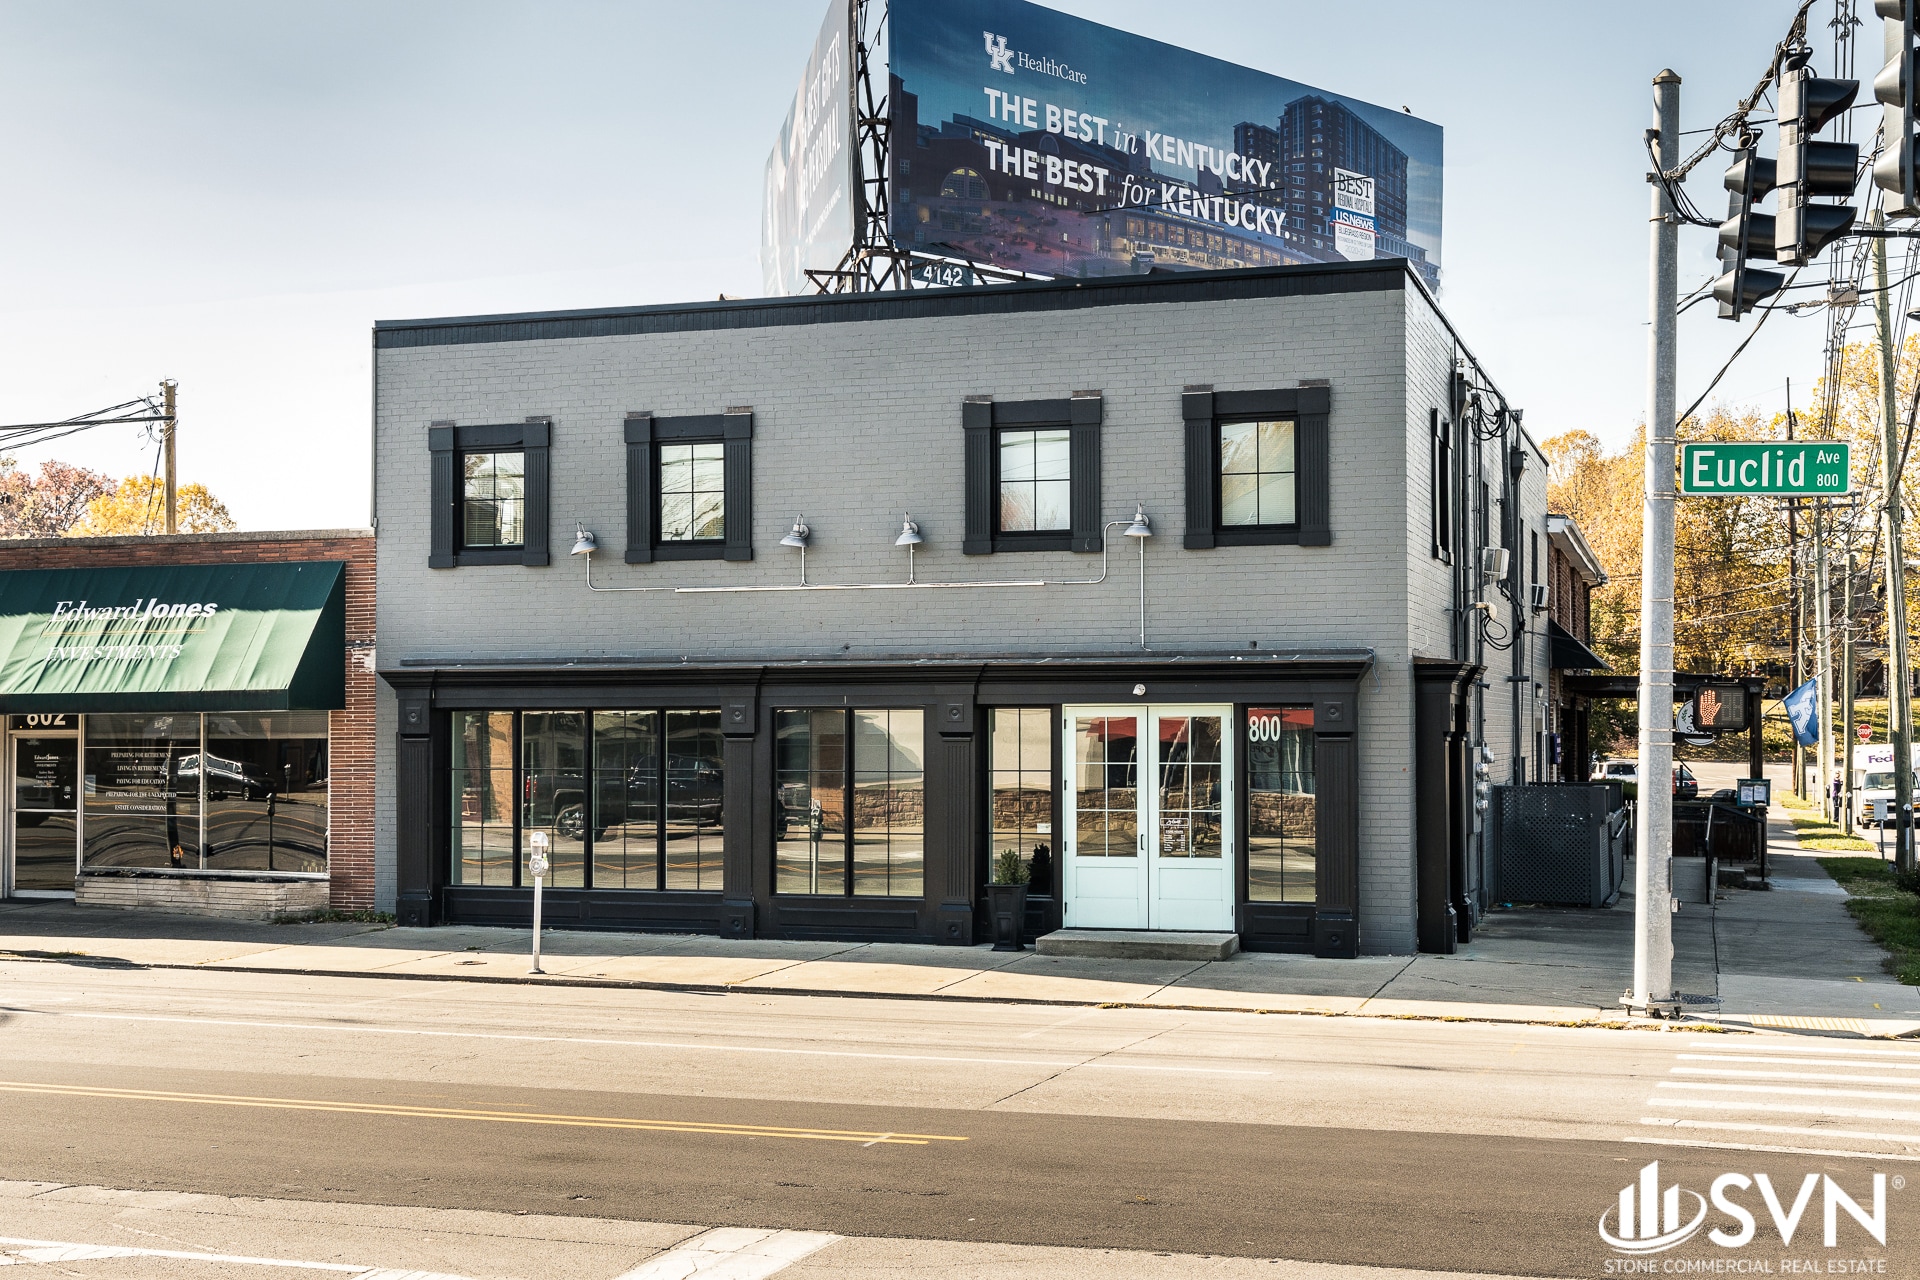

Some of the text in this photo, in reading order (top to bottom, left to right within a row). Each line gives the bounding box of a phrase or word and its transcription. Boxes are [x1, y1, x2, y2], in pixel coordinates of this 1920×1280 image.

[983, 31, 1088, 85] UK HealthCare
[984, 86, 1276, 190] THE BEST in KENTUCKY.
[984, 139, 1291, 239] THE BEST for KENTUCKY.
[1337, 173, 1372, 199] BEST
[923, 265, 963, 287] 4142
[1693, 450, 1840, 487] Euclid Ave
[1816, 473, 1839, 487] 800
[50, 598, 218, 622] Edward Jones
[45, 645, 183, 661] INVESTMENTS
[1249, 716, 1280, 742] 800
[1858, 728, 1871, 736] STOP
[1868, 754, 1894, 763] Fed
